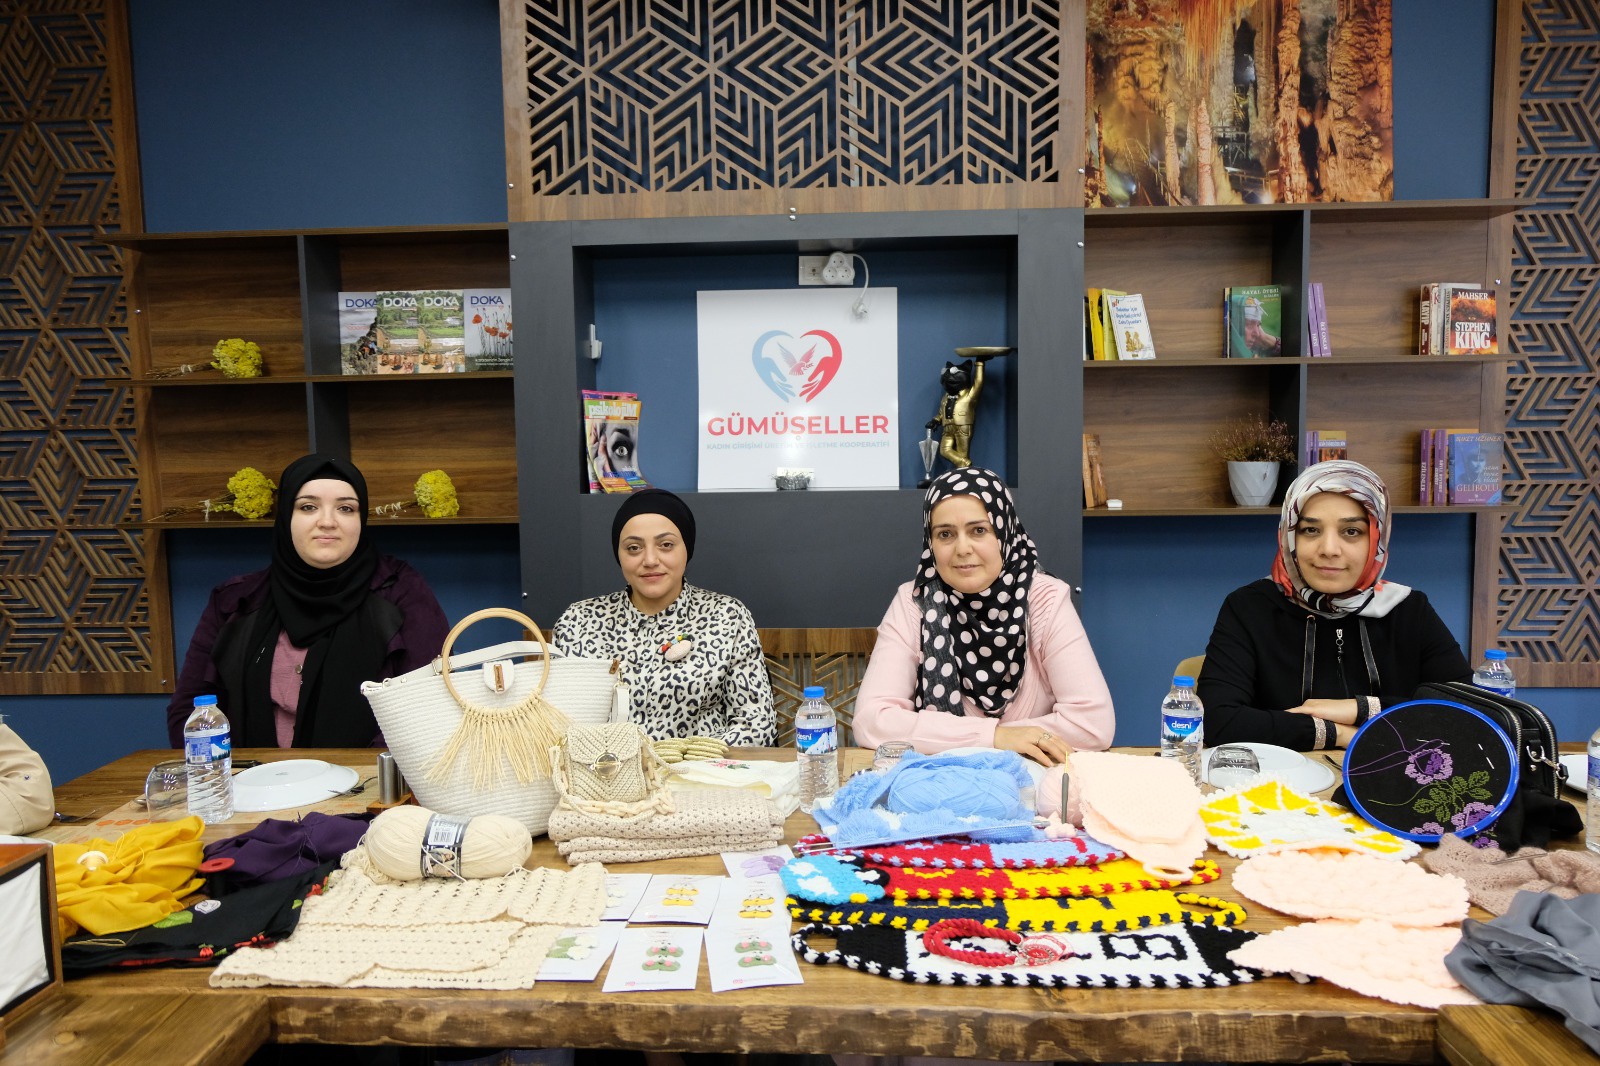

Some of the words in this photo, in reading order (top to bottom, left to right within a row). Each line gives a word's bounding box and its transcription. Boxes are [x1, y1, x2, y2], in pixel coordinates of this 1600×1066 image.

[345, 298, 378, 308] DOKA
[383, 297, 417, 308] DOKA
[424, 296, 459, 307] DOKA
[470, 295, 504, 305] DOKA
[1455, 322, 1491, 332] STEPHEN
[1455, 331, 1491, 349] KING
